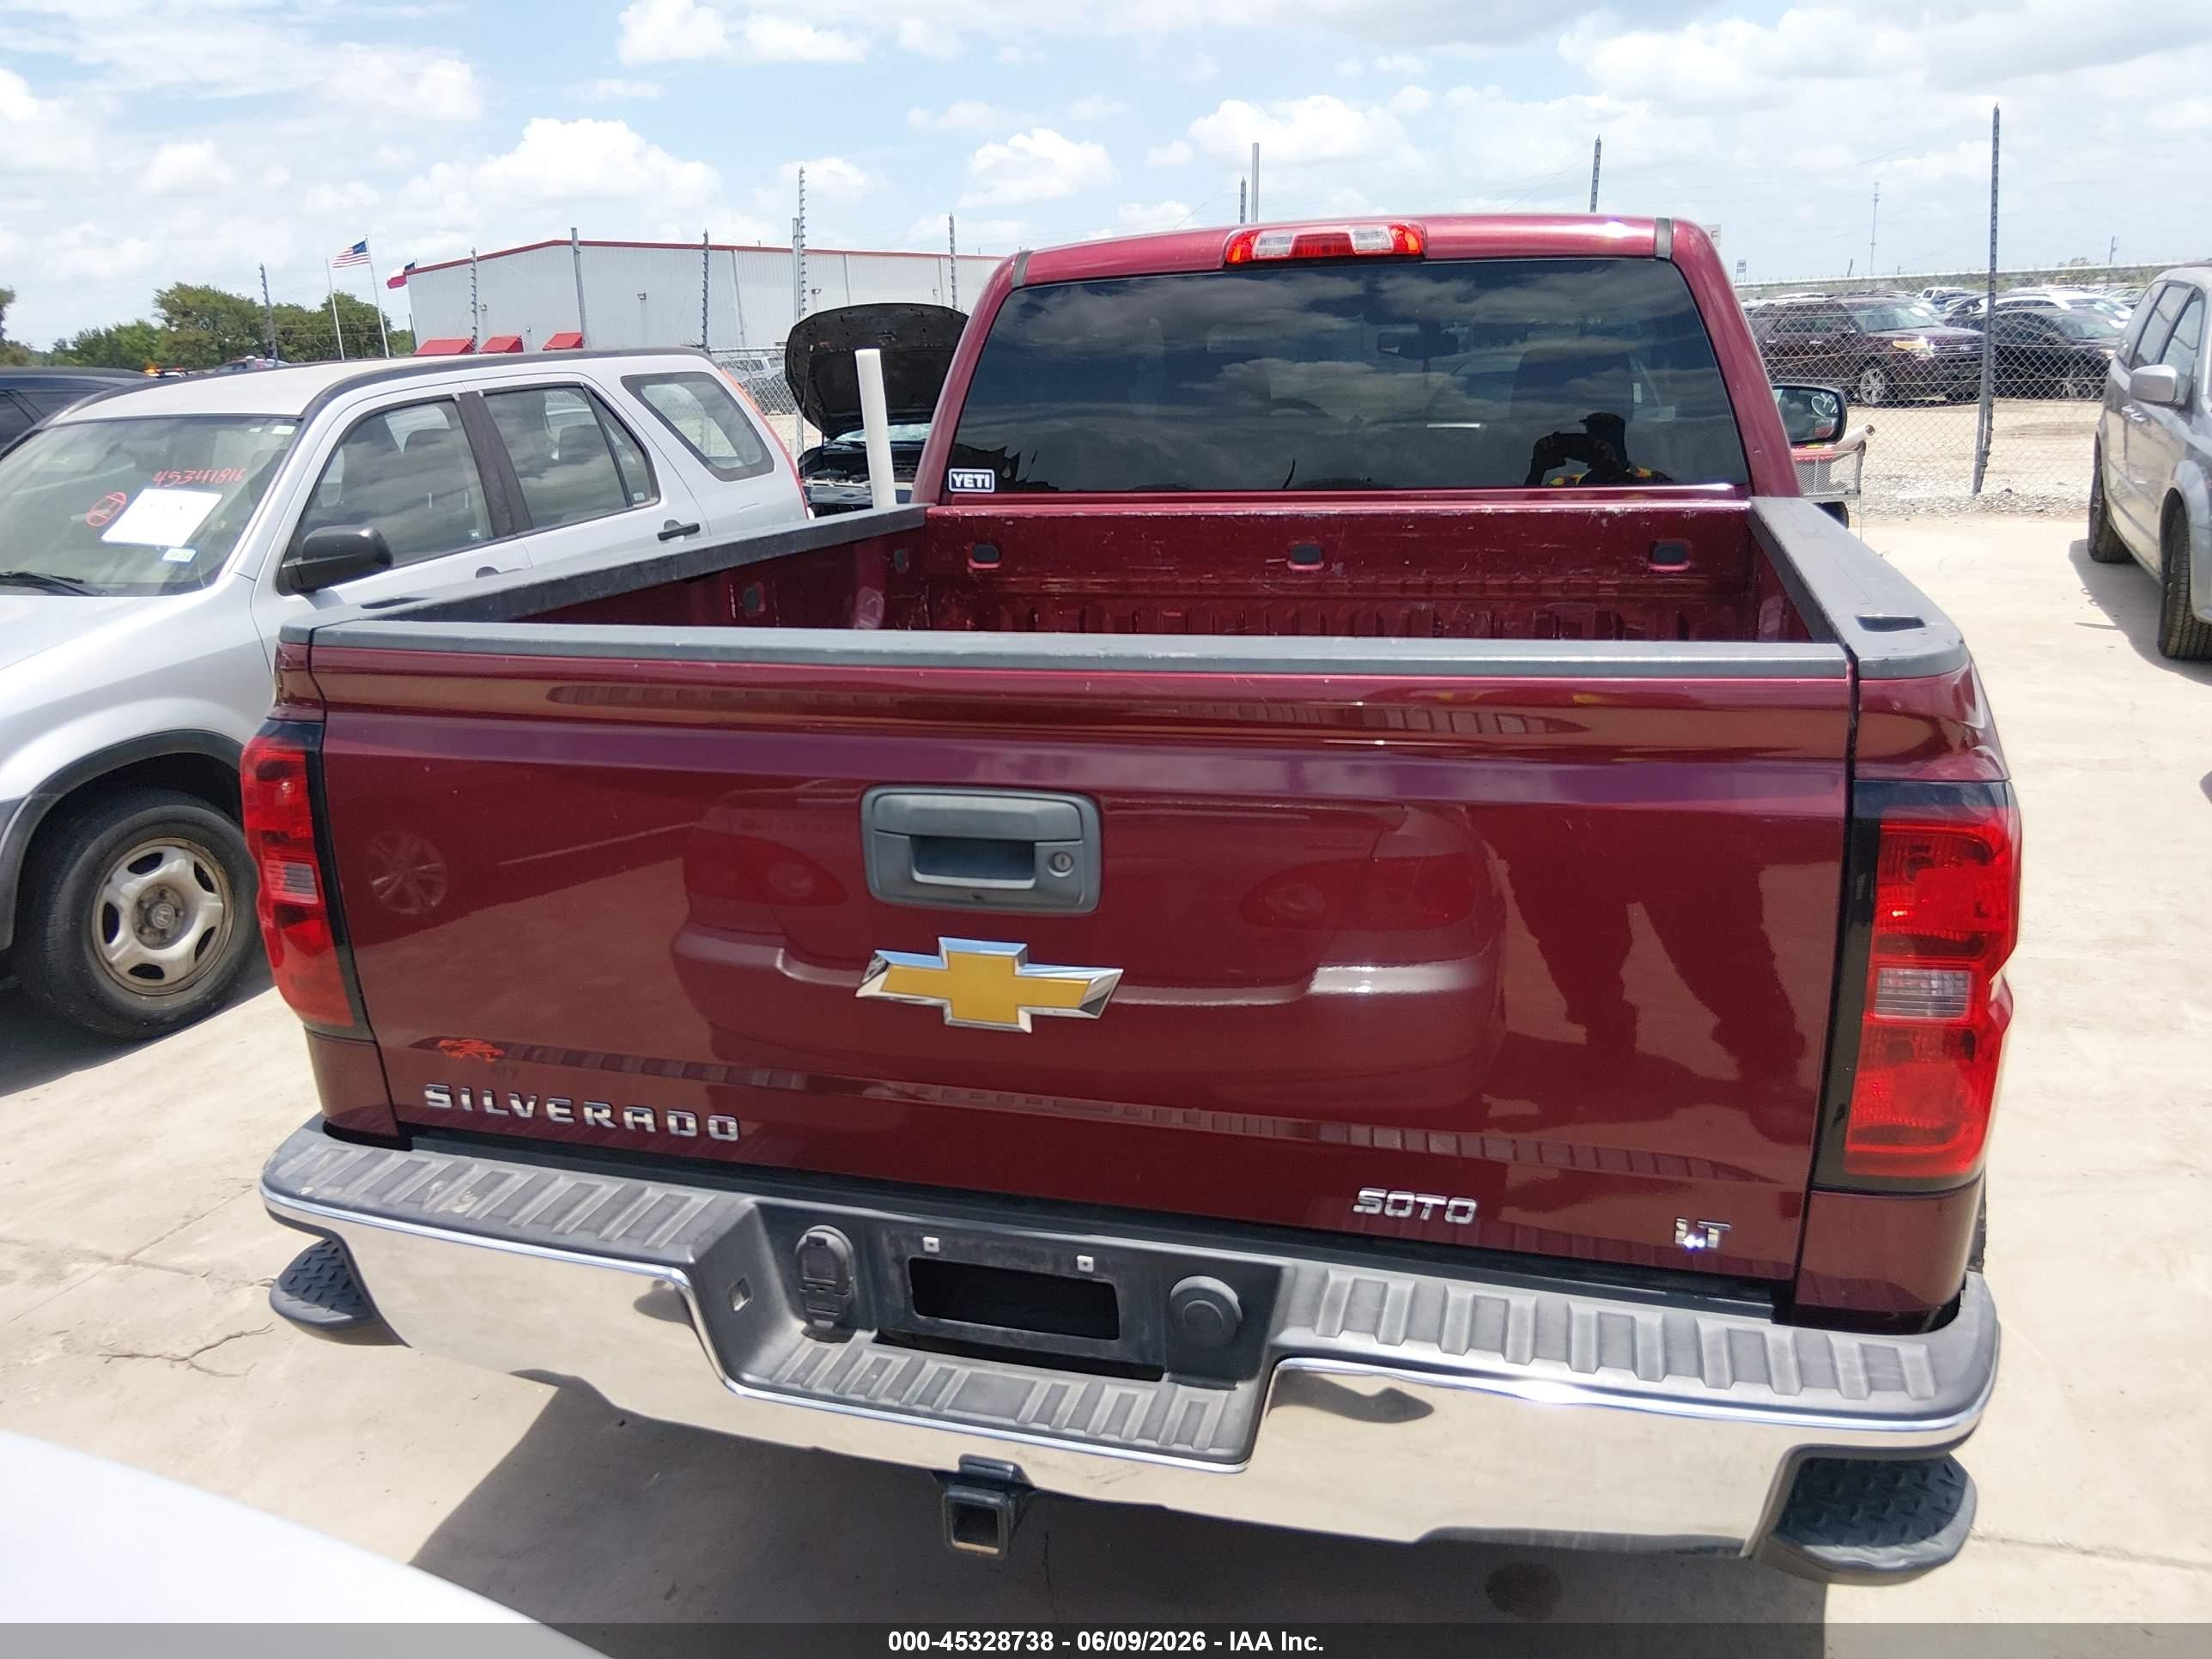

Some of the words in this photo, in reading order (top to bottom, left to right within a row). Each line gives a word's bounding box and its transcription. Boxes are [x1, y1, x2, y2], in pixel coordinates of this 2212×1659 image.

[952, 473, 990, 488] YETI
[424, 1083, 740, 1141] SILVERADO
[1353, 1187, 1477, 1224] SOTO
[1675, 1217, 1731, 1249] LT
